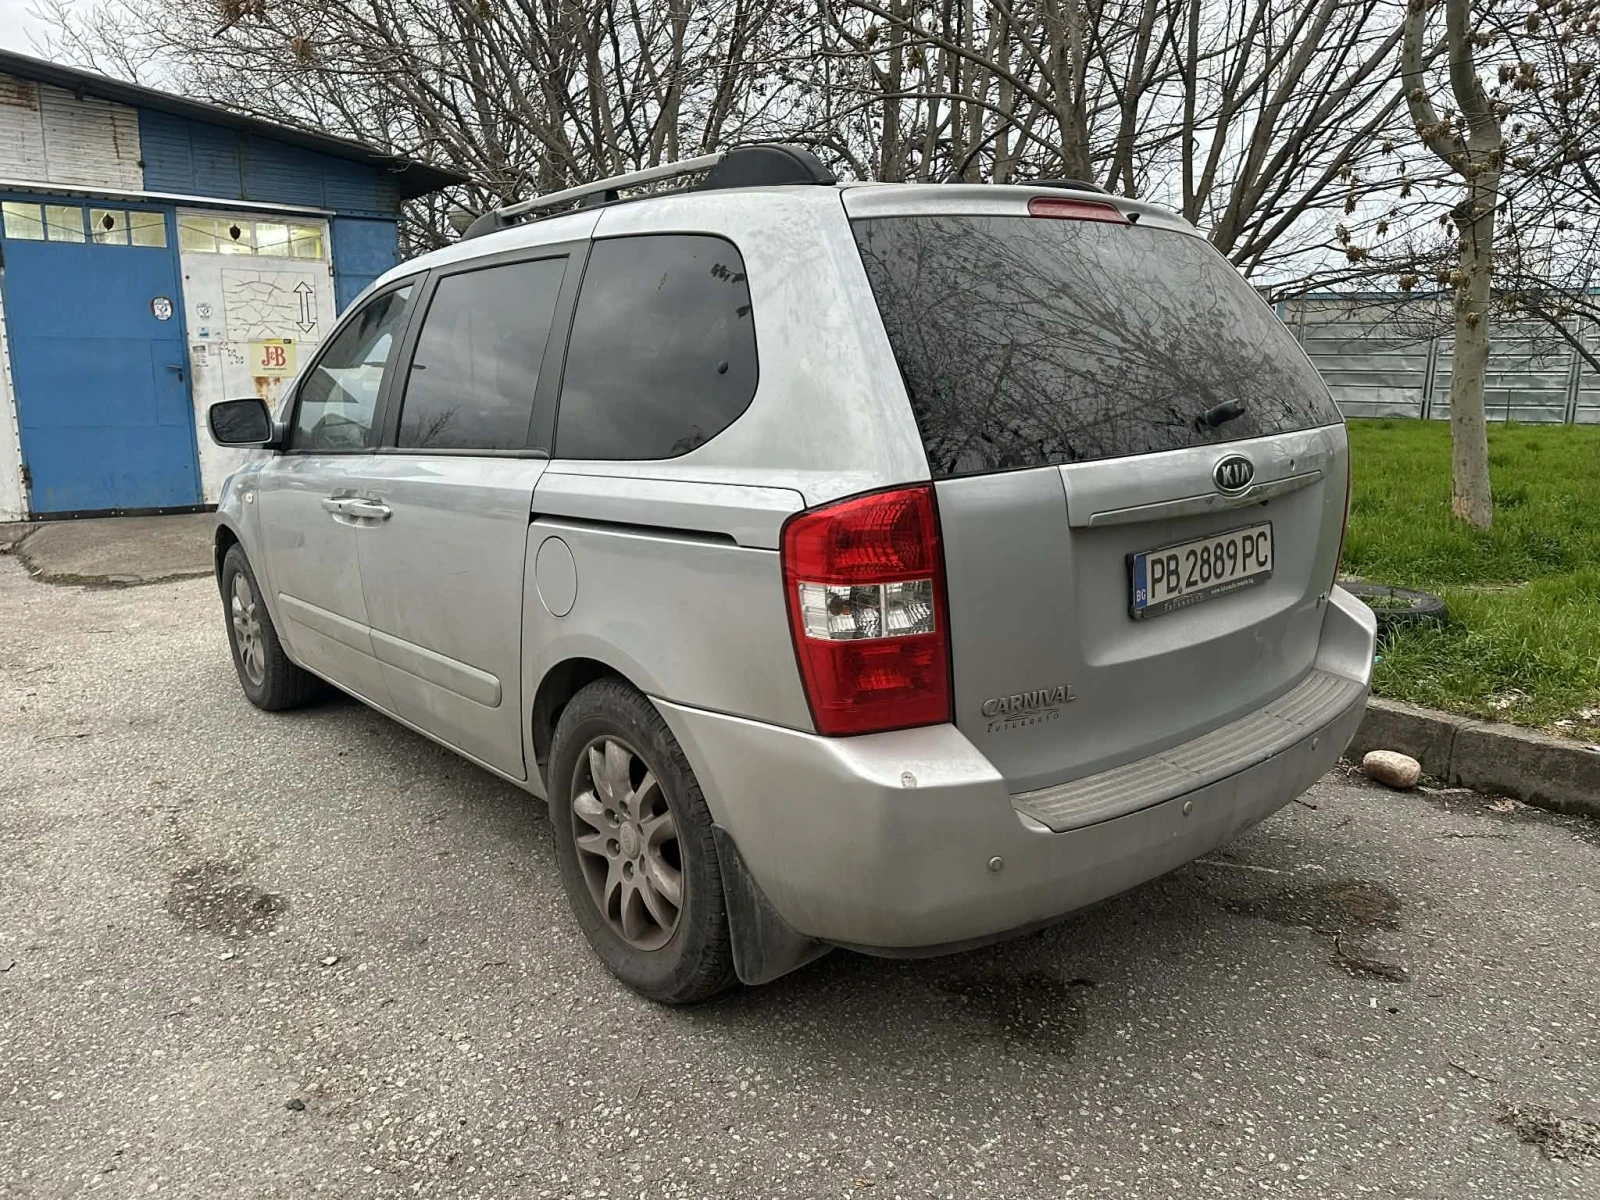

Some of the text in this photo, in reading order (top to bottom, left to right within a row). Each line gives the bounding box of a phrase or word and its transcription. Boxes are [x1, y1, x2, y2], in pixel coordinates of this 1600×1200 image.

[261, 346, 287, 367] J&B
[1221, 463, 1250, 486] KIA
[1136, 588, 1146, 601] BG
[982, 685, 1076, 718] CARNIVAL
